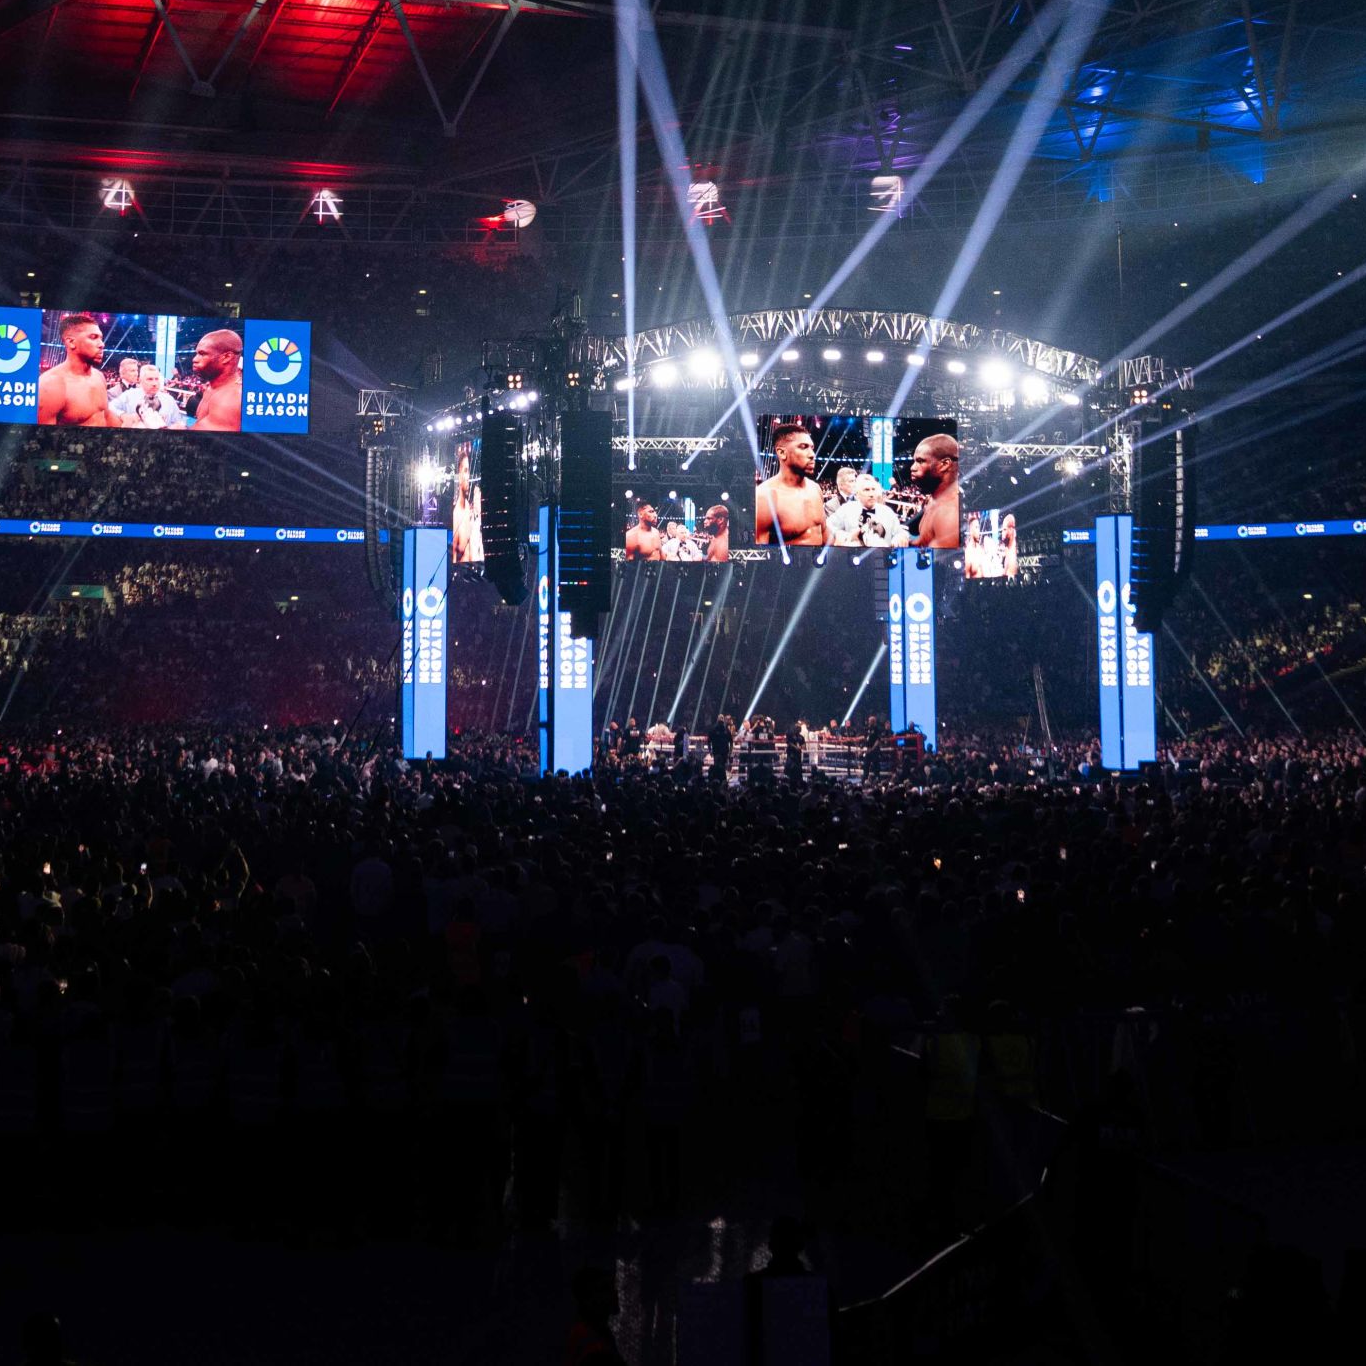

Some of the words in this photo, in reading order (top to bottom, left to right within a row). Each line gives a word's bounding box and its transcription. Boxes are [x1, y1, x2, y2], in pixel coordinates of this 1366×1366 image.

[246, 404, 308, 417] SEASON
[247, 391, 308, 404] RIYADH
[419, 619, 430, 683] SEASON
[431, 619, 442, 683] RIYADH
[574, 637, 587, 689] YADH
[909, 623, 920, 684] SEASON
[920, 623, 931, 684] RIYADH
[1138, 637, 1150, 686] YADH
